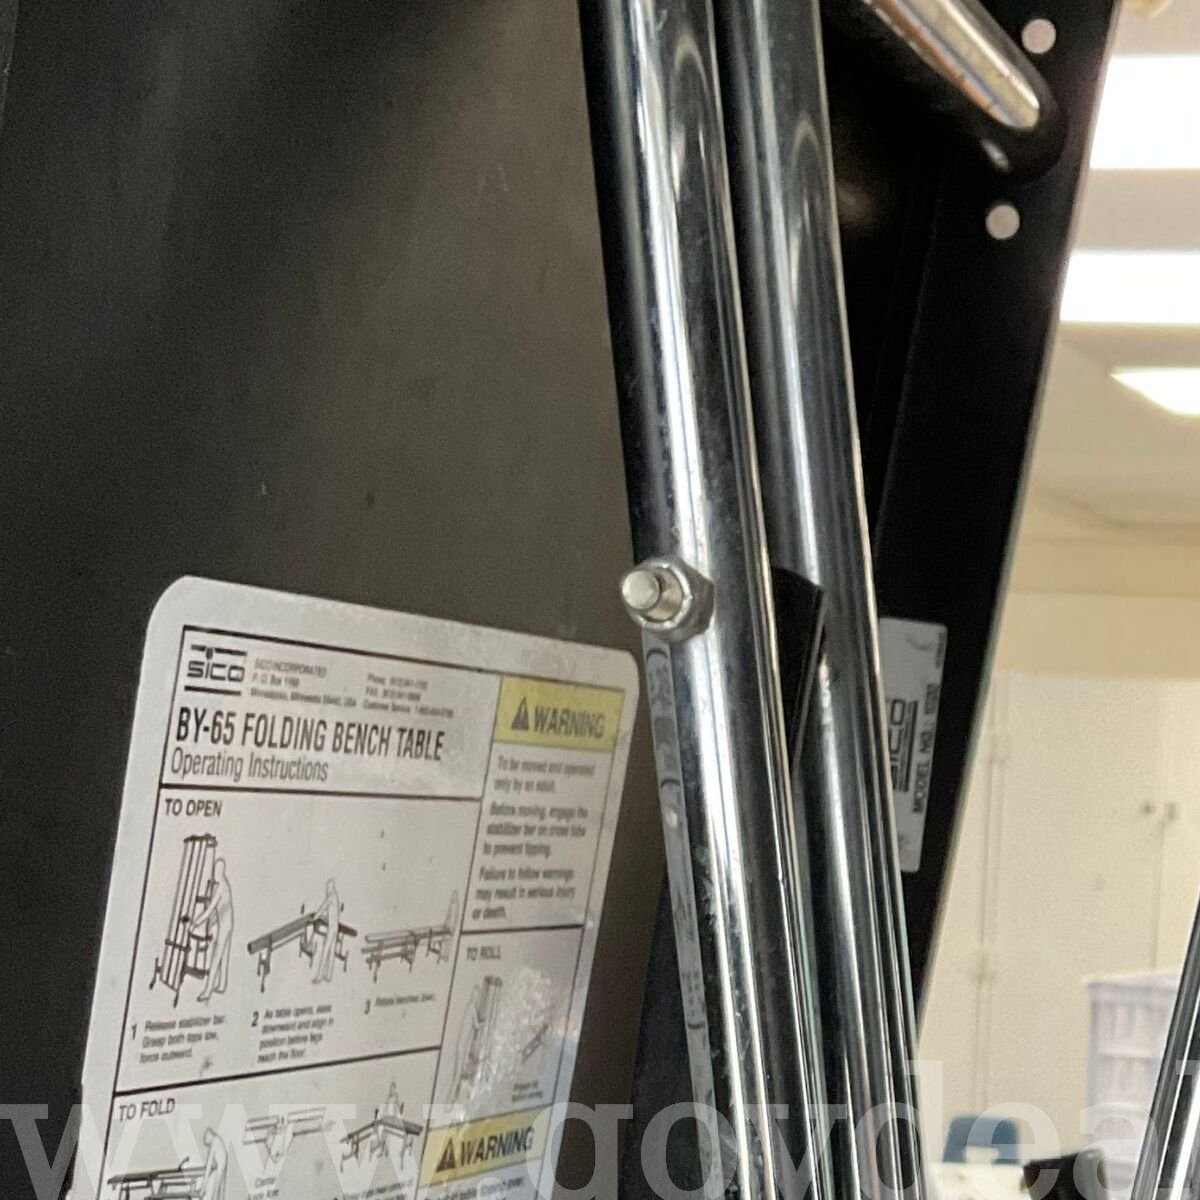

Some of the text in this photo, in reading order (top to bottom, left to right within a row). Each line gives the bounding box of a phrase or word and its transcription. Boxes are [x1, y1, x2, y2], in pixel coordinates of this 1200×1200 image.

[187, 661, 245, 682] SICO
[176, 707, 445, 761] BY-65 FOLDING BENCH TABLE
[534, 706, 605, 740] WARNING
[171, 746, 328, 782] Operating Instructions
[164, 799, 222, 818] TO OPEN
[119, 1098, 175, 1123] TO FOLD
[460, 1125, 534, 1167] WARNING
